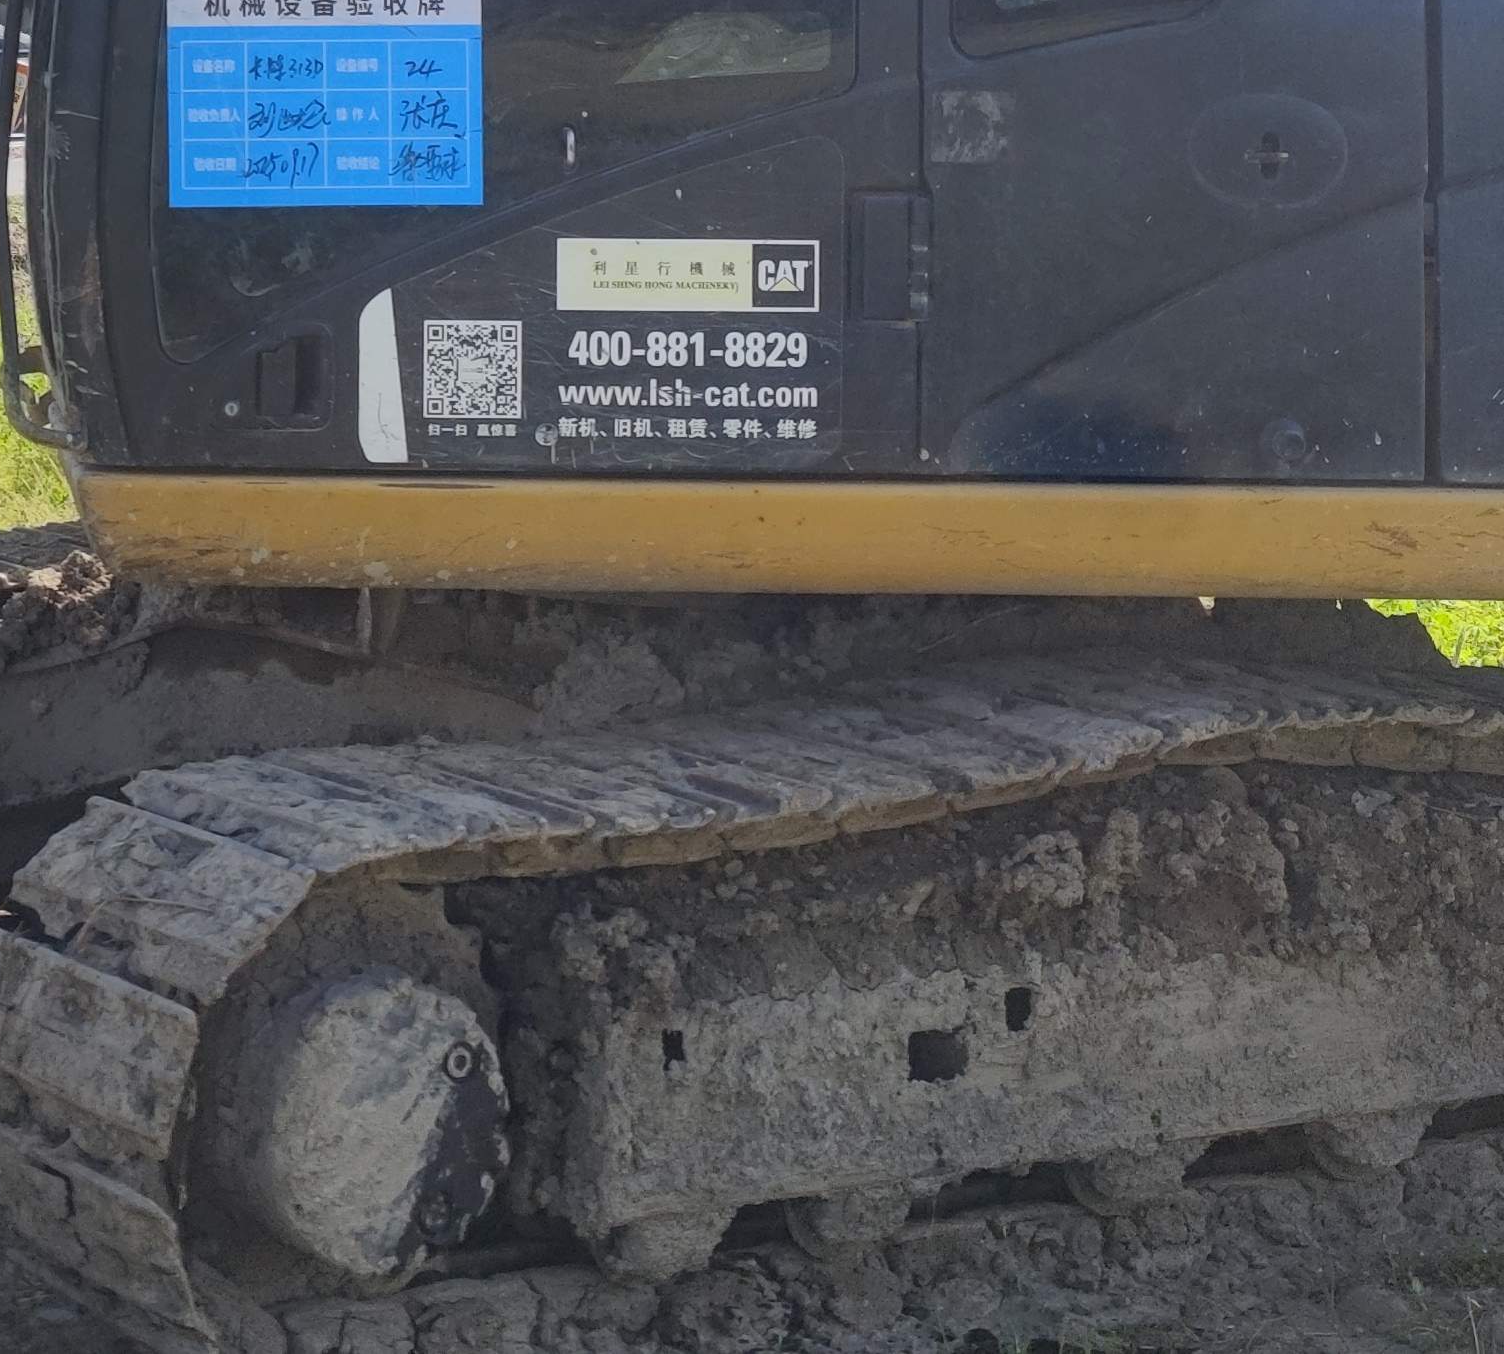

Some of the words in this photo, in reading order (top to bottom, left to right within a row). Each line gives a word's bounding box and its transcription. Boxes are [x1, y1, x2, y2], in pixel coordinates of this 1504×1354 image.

[405, 59, 443, 77] 24
[593, 261, 736, 276] 利星行機械
[757, 259, 810, 292] CAT
[611, 280, 643, 289] SHING
[568, 330, 808, 368] 400-881-8829
[558, 378, 818, 408] www.lsh-cat.com
[428, 423, 468, 437] 扫一扫
[558, 417, 817, 441] 新机、旧机、租赁、零件、维修
